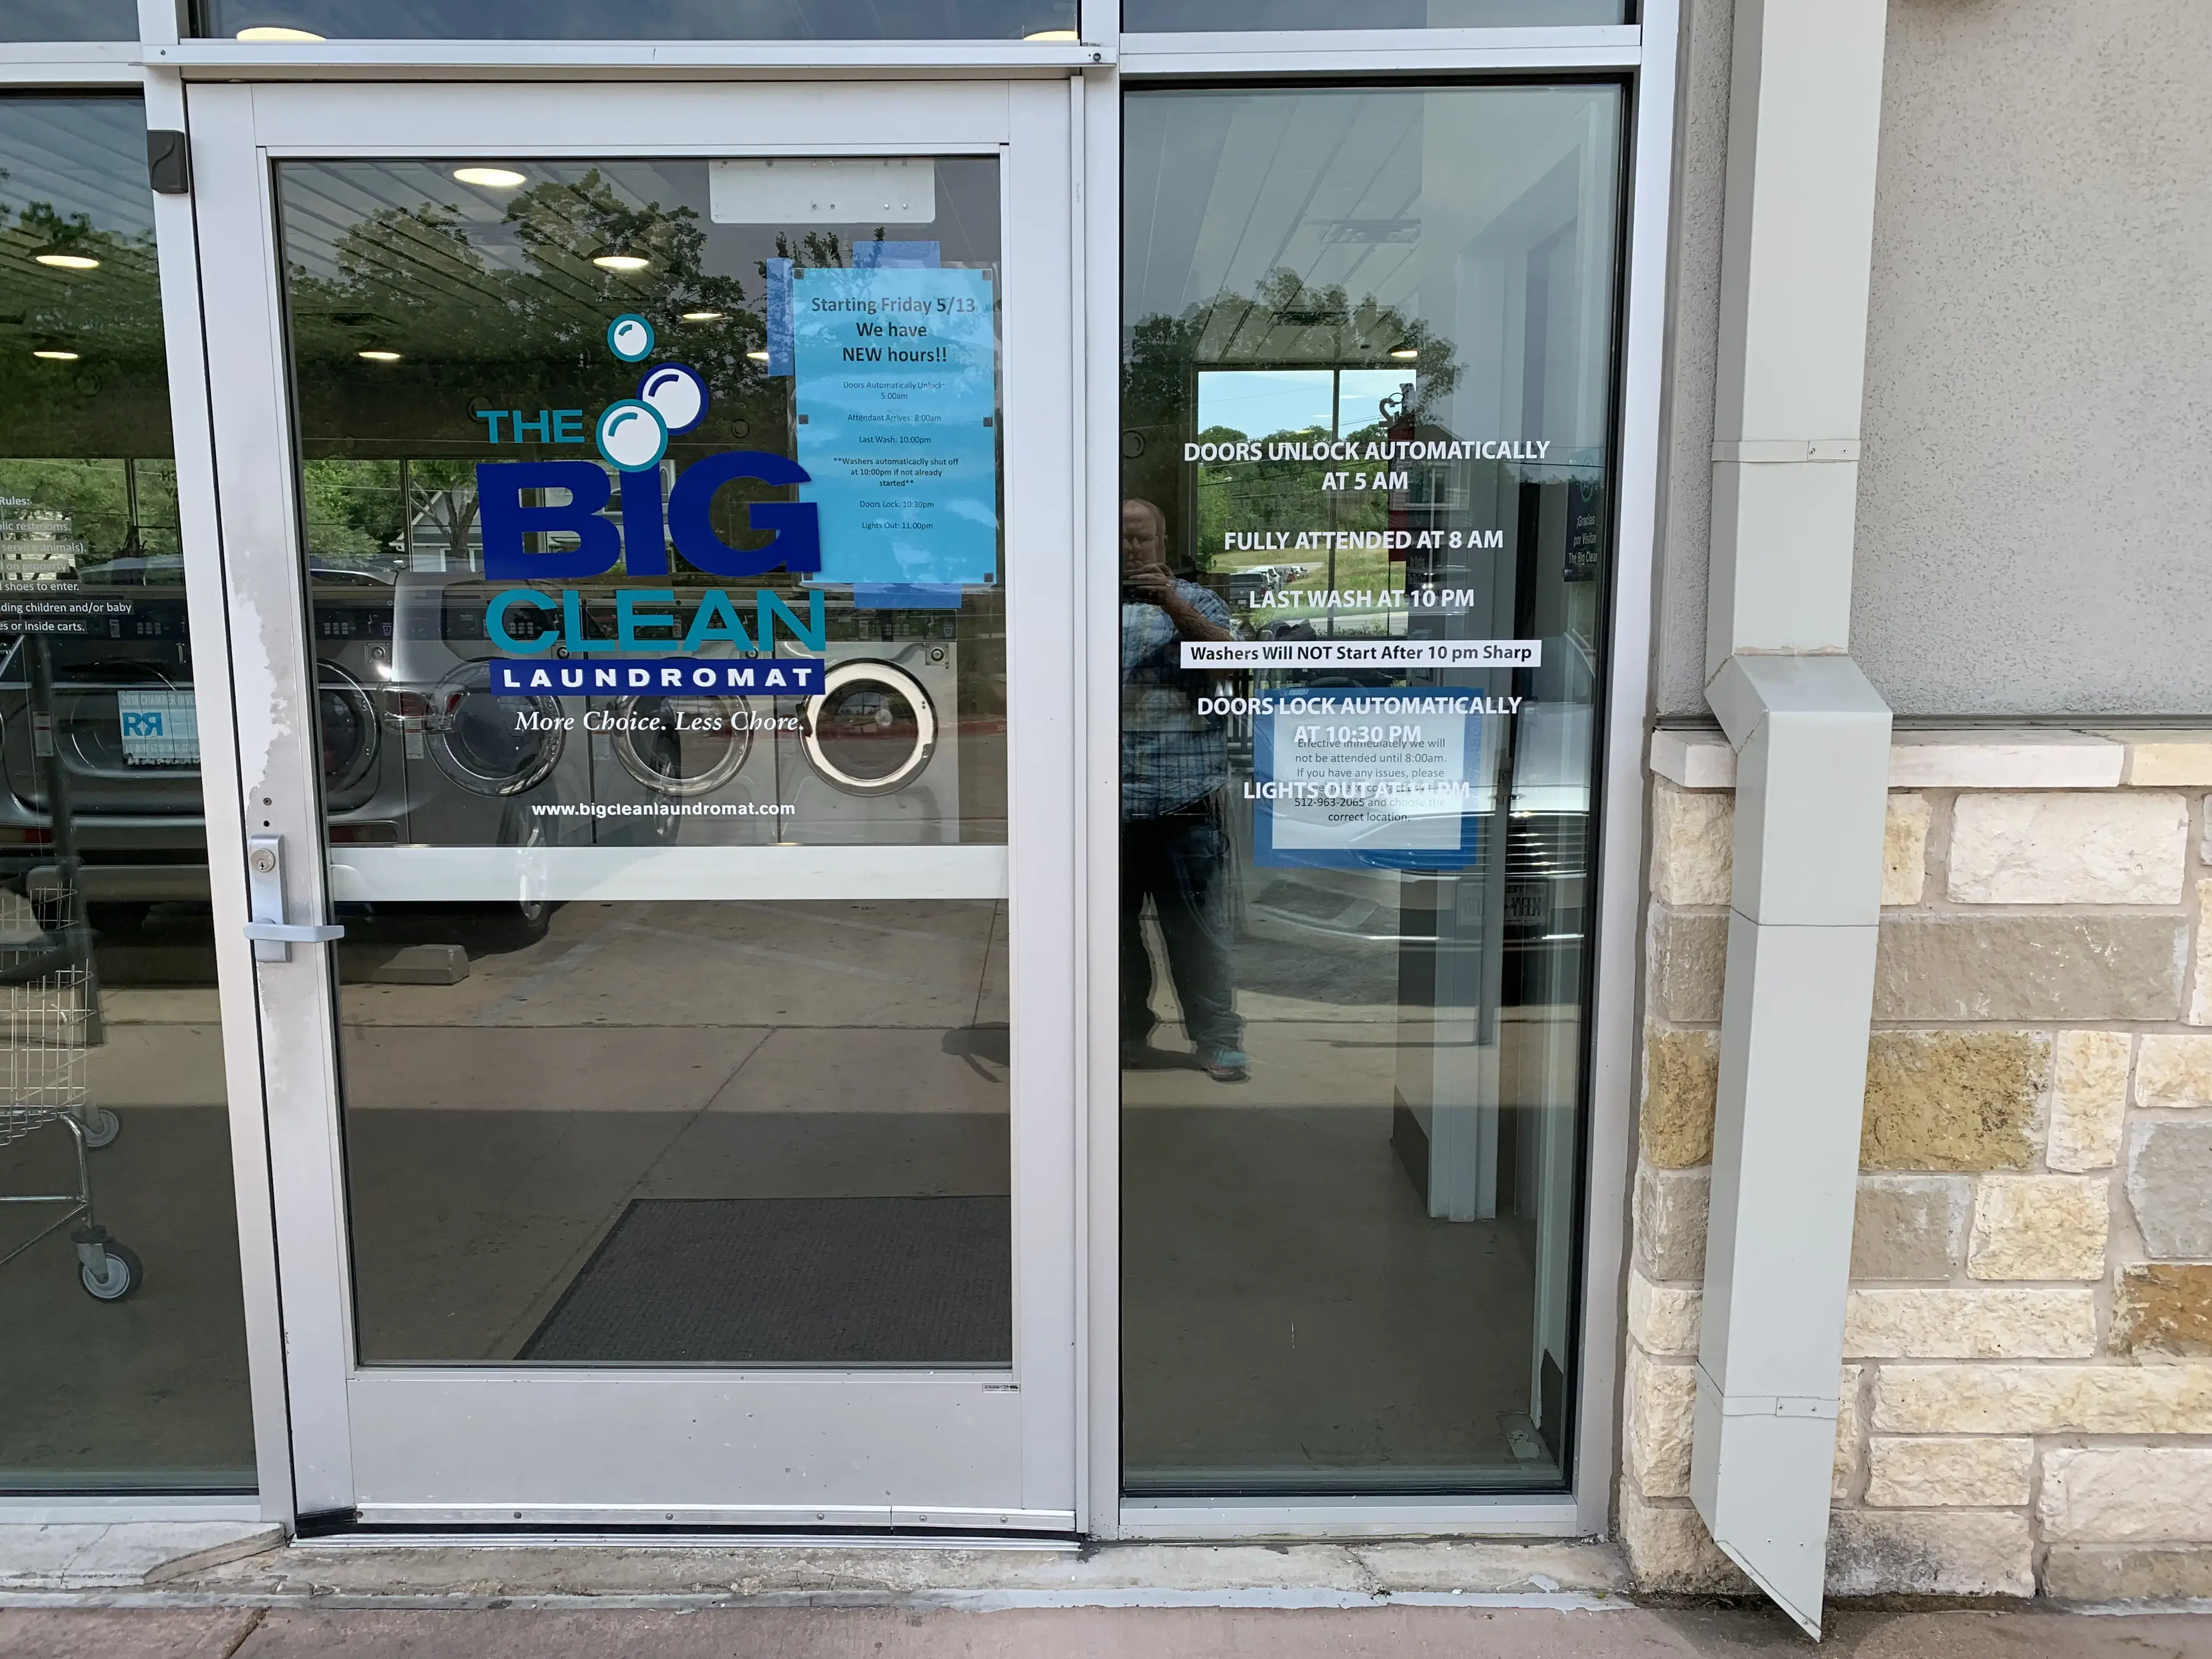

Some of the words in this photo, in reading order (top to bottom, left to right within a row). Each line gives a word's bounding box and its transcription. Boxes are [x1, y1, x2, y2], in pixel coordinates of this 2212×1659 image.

[811, 297, 877, 315] Starting
[881, 297, 932, 315] Friday
[936, 296, 975, 315] 5/13
[856, 322, 883, 337] We
[888, 322, 927, 337] have
[843, 347, 882, 362] NEW
[888, 347, 947, 362] hours!!
[866, 381, 916, 390] Automatically
[476, 409, 585, 444] THE
[1184, 443, 1262, 462] DOORS
[1268, 442, 1359, 461] UNLOCK
[1364, 441, 1550, 460] AUTOMATICALLY
[915, 469, 943, 477] already
[1322, 472, 1348, 490] AT
[1355, 473, 1367, 490] 5
[1373, 472, 1408, 490] AM
[0, 496, 30, 505] Rules:
[902, 501, 935, 509] 10:30pm
[476, 451, 821, 580] BIG
[16, 521, 71, 532] restrooms.
[862, 522, 883, 531] Lights
[42, 542, 87, 552] animals).
[1225, 532, 1289, 550] FULLY
[1295, 531, 1412, 550] ATTENDED
[1417, 531, 1444, 549] AT
[1449, 531, 1462, 549] 8
[1468, 530, 1503, 549] AM
[5, 582, 34, 591] shoes
[37, 582, 48, 591] to
[50, 582, 80, 591] enter.
[1250, 591, 1304, 608] LAST
[1307, 590, 1372, 608] WASH
[1378, 590, 1404, 607] AT
[1411, 590, 1436, 607] 10
[1442, 589, 1474, 607] PM
[25, 602, 67, 613] children
[69, 602, 104, 614] and/or
[106, 602, 132, 614] baby
[11, 622, 22, 631] or
[24, 620, 54, 631] inside
[57, 622, 85, 631] carts.
[486, 589, 826, 654] CLEAN
[1190, 646, 1259, 661] Washers
[1262, 646, 1293, 661] Will
[1297, 647, 1333, 660] NOT
[1336, 646, 1377, 660] Start
[1381, 646, 1423, 659] After
[1429, 646, 1448, 659] 10
[1452, 648, 1479, 663] pm
[1483, 645, 1532, 663] Sharp
[503, 667, 812, 688] LAUNDROMAT
[1198, 697, 1273, 715] DOORS
[1279, 697, 1335, 715] LOCK
[1341, 697, 1522, 714] AUTOMATICALLY
[514, 711, 574, 731] More
[583, 710, 667, 731] Choice.
[674, 712, 723, 731] Less
[731, 710, 805, 731] Chore.
[1294, 726, 1320, 743] AT
[1327, 726, 1383, 743] 10:30
[1389, 726, 1421, 743] PM
[1428, 739, 1446, 748] will
[1295, 754, 1312, 763] not
[1315, 753, 1328, 763] be
[1330, 753, 1376, 763] attended
[1380, 753, 1402, 763] until
[1405, 753, 1447, 763] 8:00am.
[1297, 768, 1305, 777] If
[1307, 770, 1325, 780] you
[1328, 768, 1352, 777] have
[1355, 770, 1372, 780] any
[1375, 768, 1408, 779] issues,
[1412, 768, 1444, 780] please
[1243, 782, 1318, 799] LIGHTS
[1324, 782, 1368, 799] OUT
[1374, 782, 1401, 799] AT
[1437, 782, 1470, 799] PM
[532, 800, 795, 817] www.bigcleanlaundromat.com
[1294, 798, 1365, 807] 512-963-2065
[1368, 798, 1386, 807] and
[1389, 798, 1426, 807] choose
[1428, 798, 1445, 807] the
[1328, 813, 1364, 822] correct
[1367, 812, 1410, 822] location.
